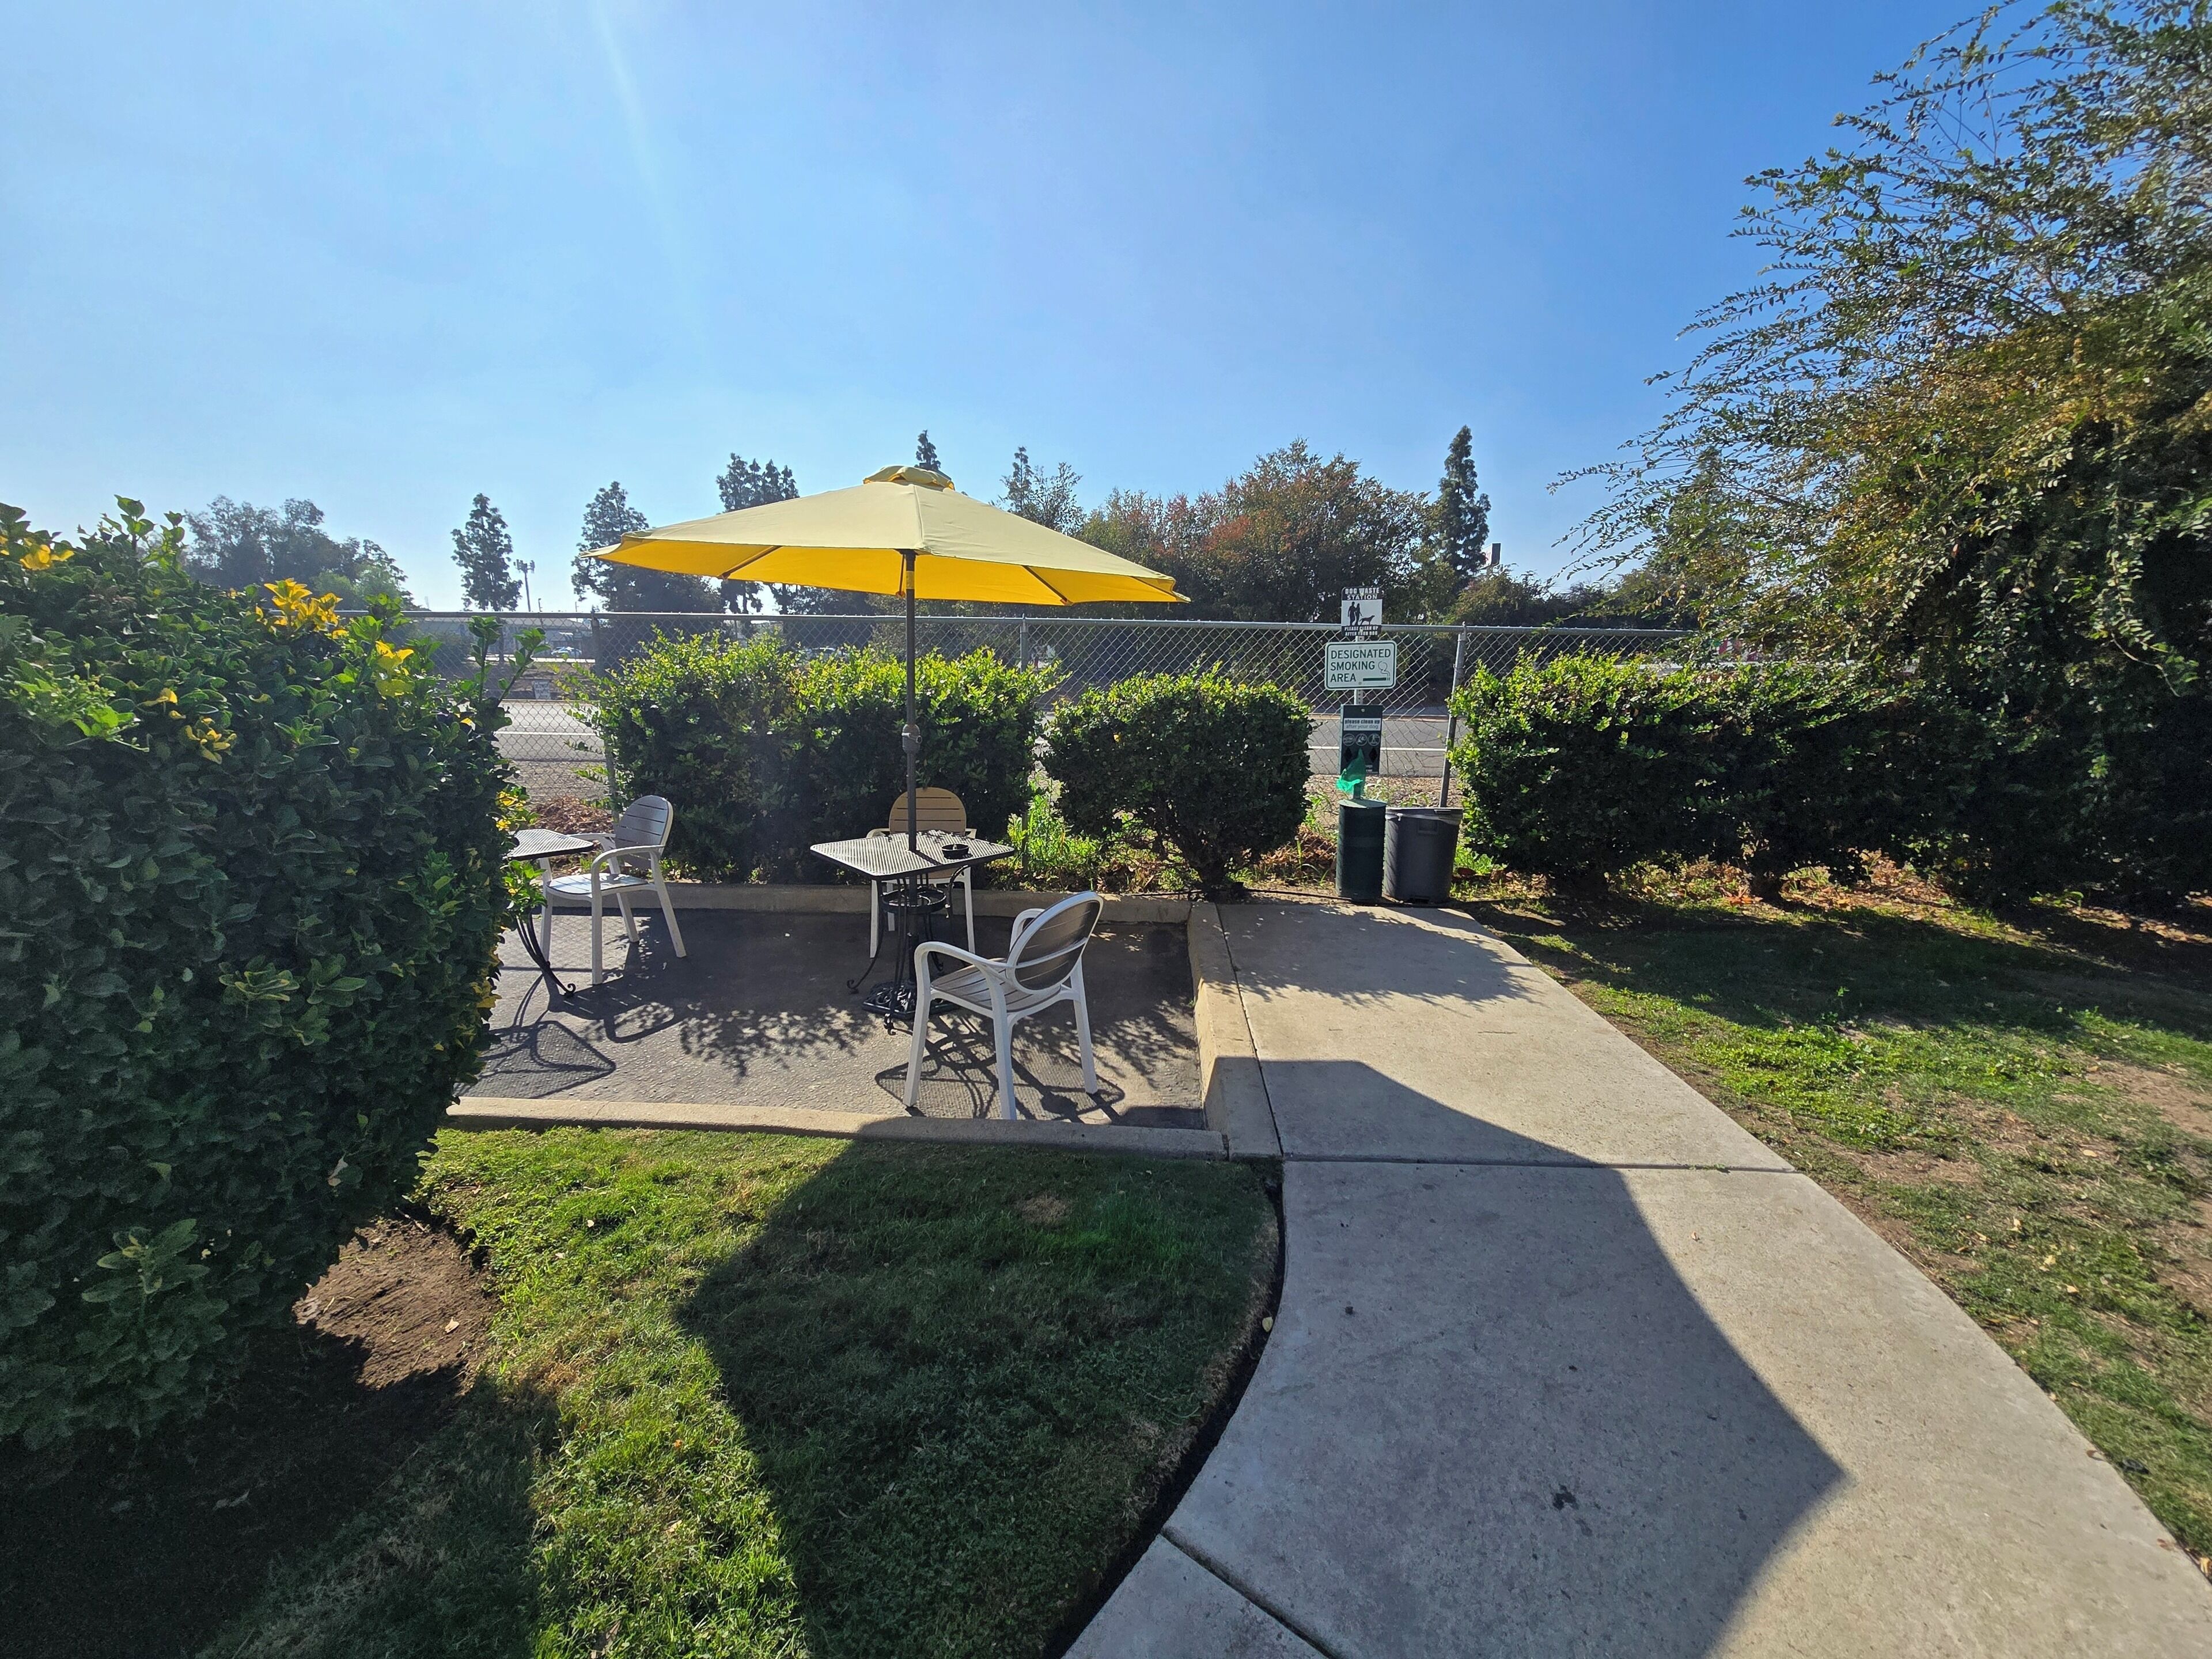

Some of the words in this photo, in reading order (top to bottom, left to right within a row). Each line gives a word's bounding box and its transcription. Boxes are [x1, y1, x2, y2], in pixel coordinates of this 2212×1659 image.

[1331, 649, 1391, 659] DESIGNATED
[1330, 661, 1375, 671] SMOKING
[1330, 673, 1357, 683] AREA
